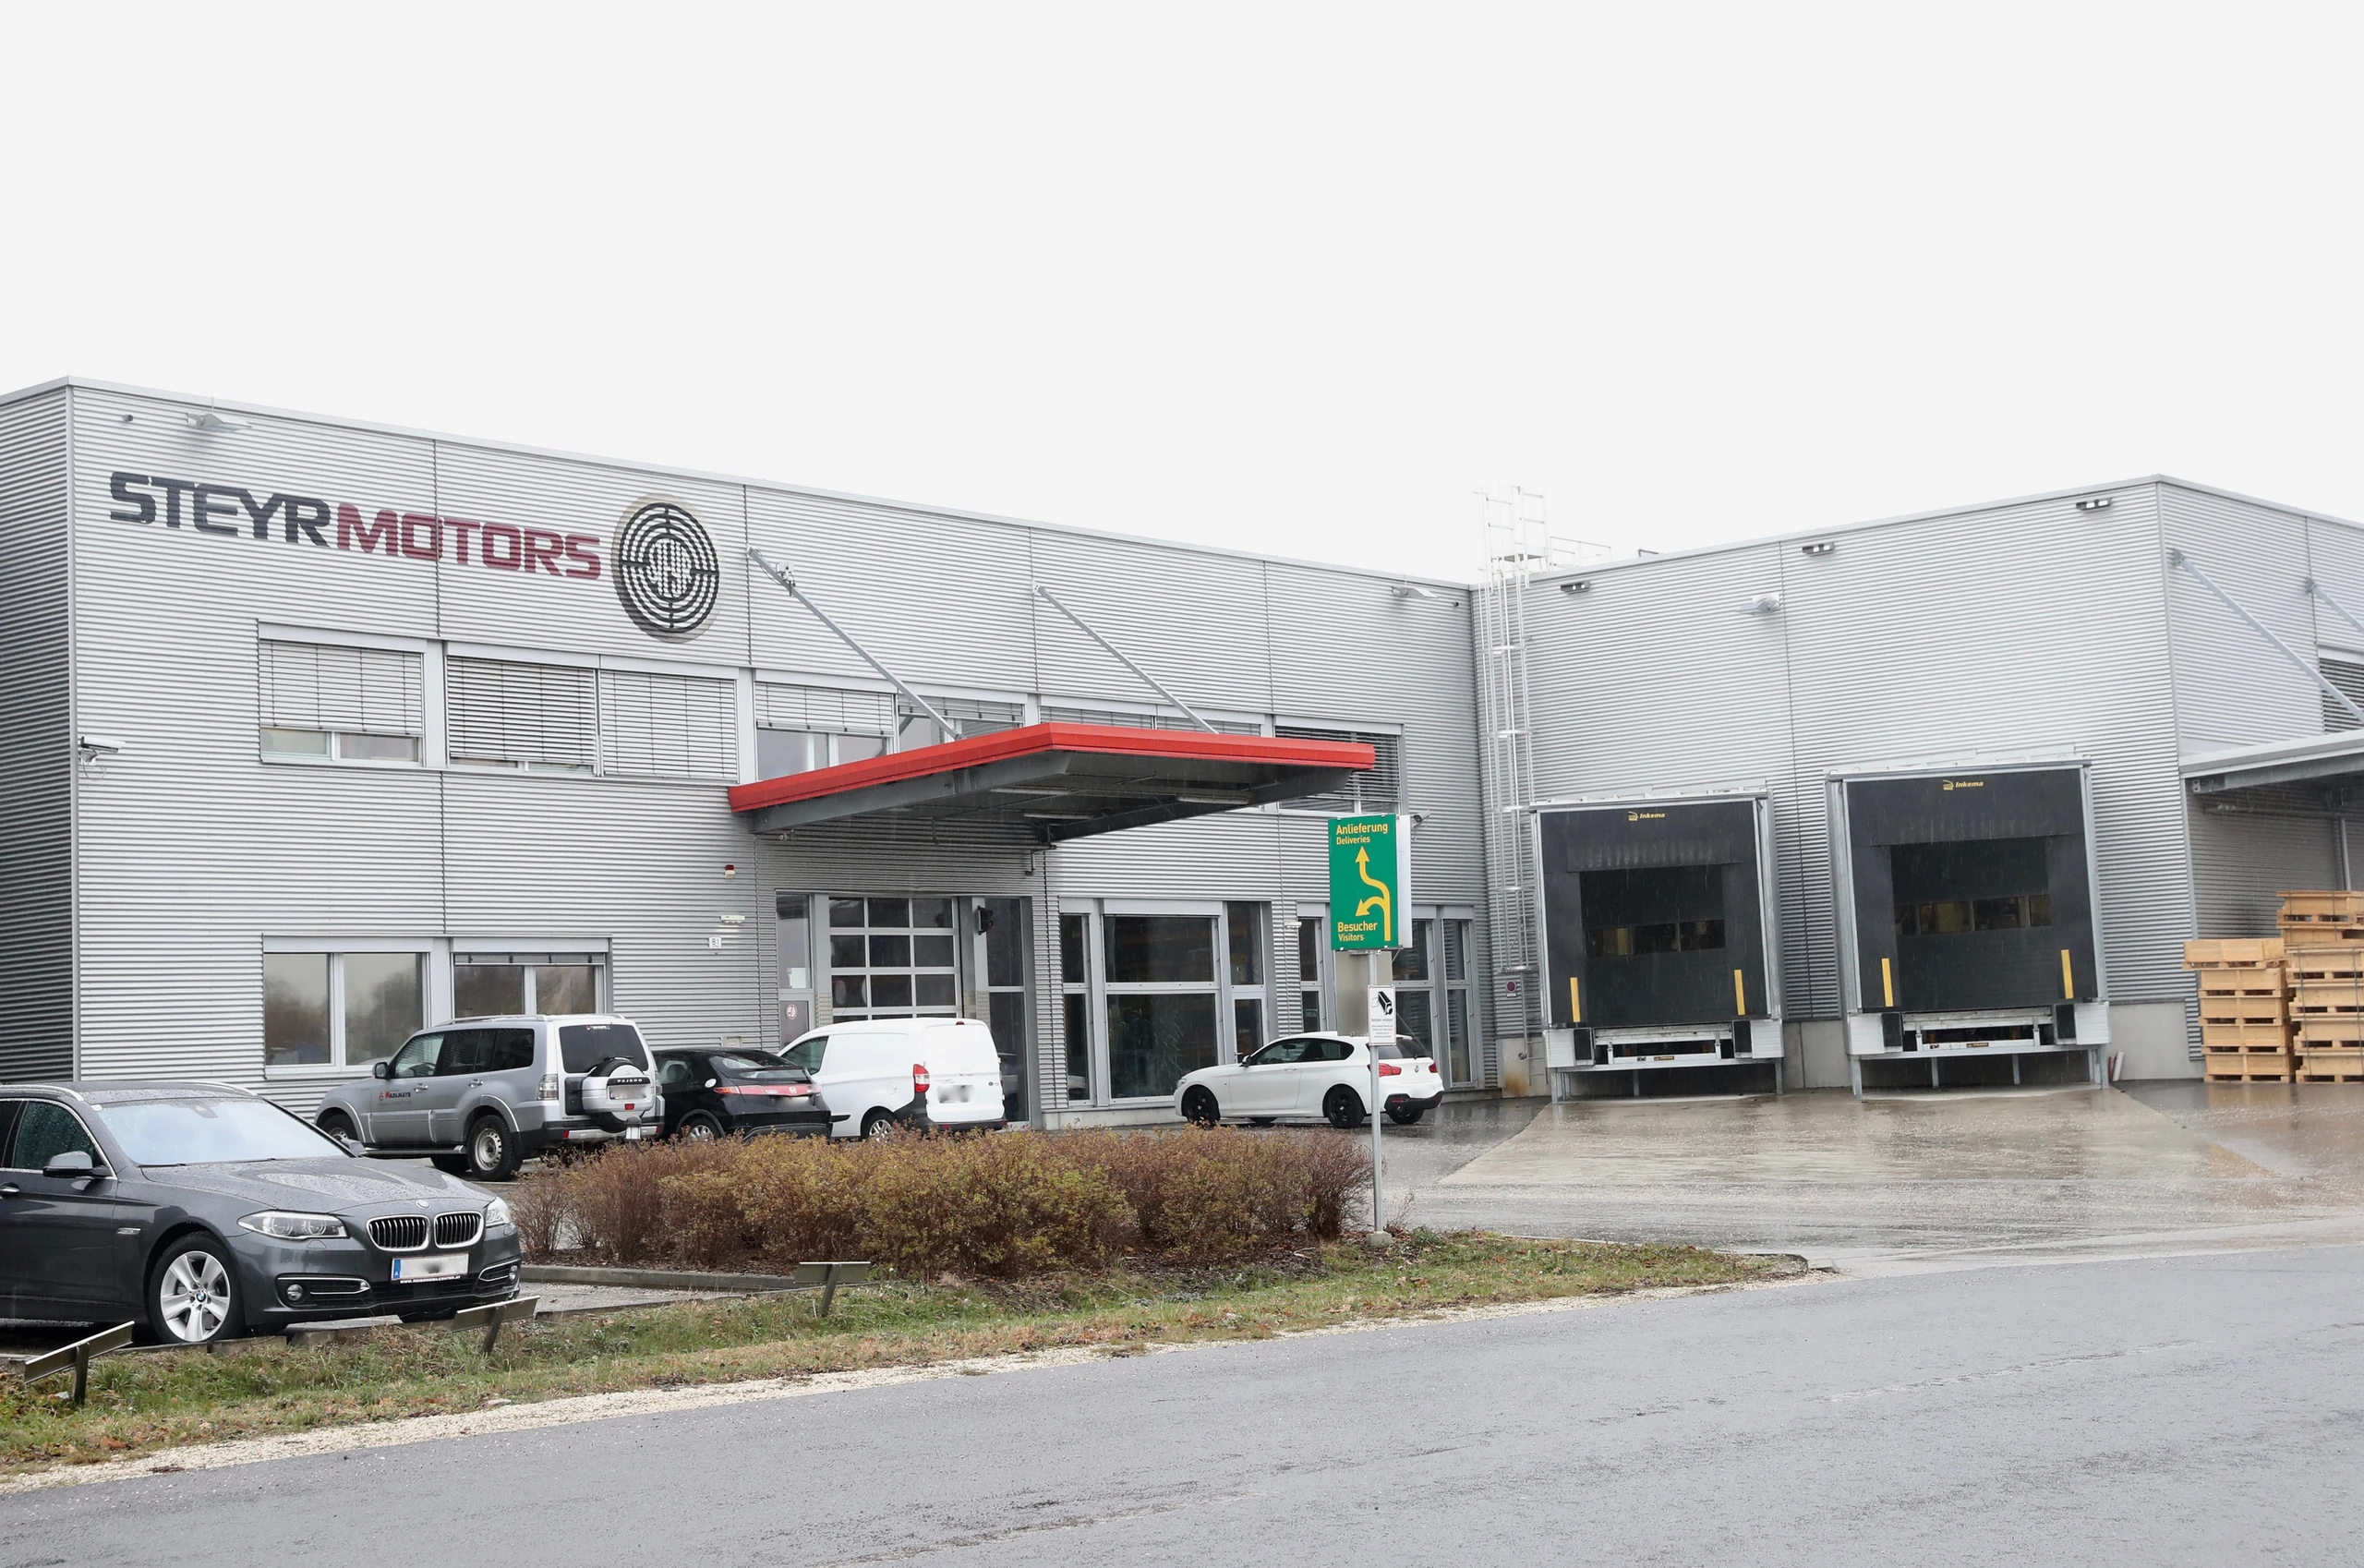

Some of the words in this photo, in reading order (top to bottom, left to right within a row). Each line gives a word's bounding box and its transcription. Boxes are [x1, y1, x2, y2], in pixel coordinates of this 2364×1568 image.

[1335, 823, 1388, 835] Anlieferung
[1336, 835, 1371, 845] Deliveries
[1337, 921, 1378, 933] Besucher
[1338, 933, 1365, 942] Visitors
